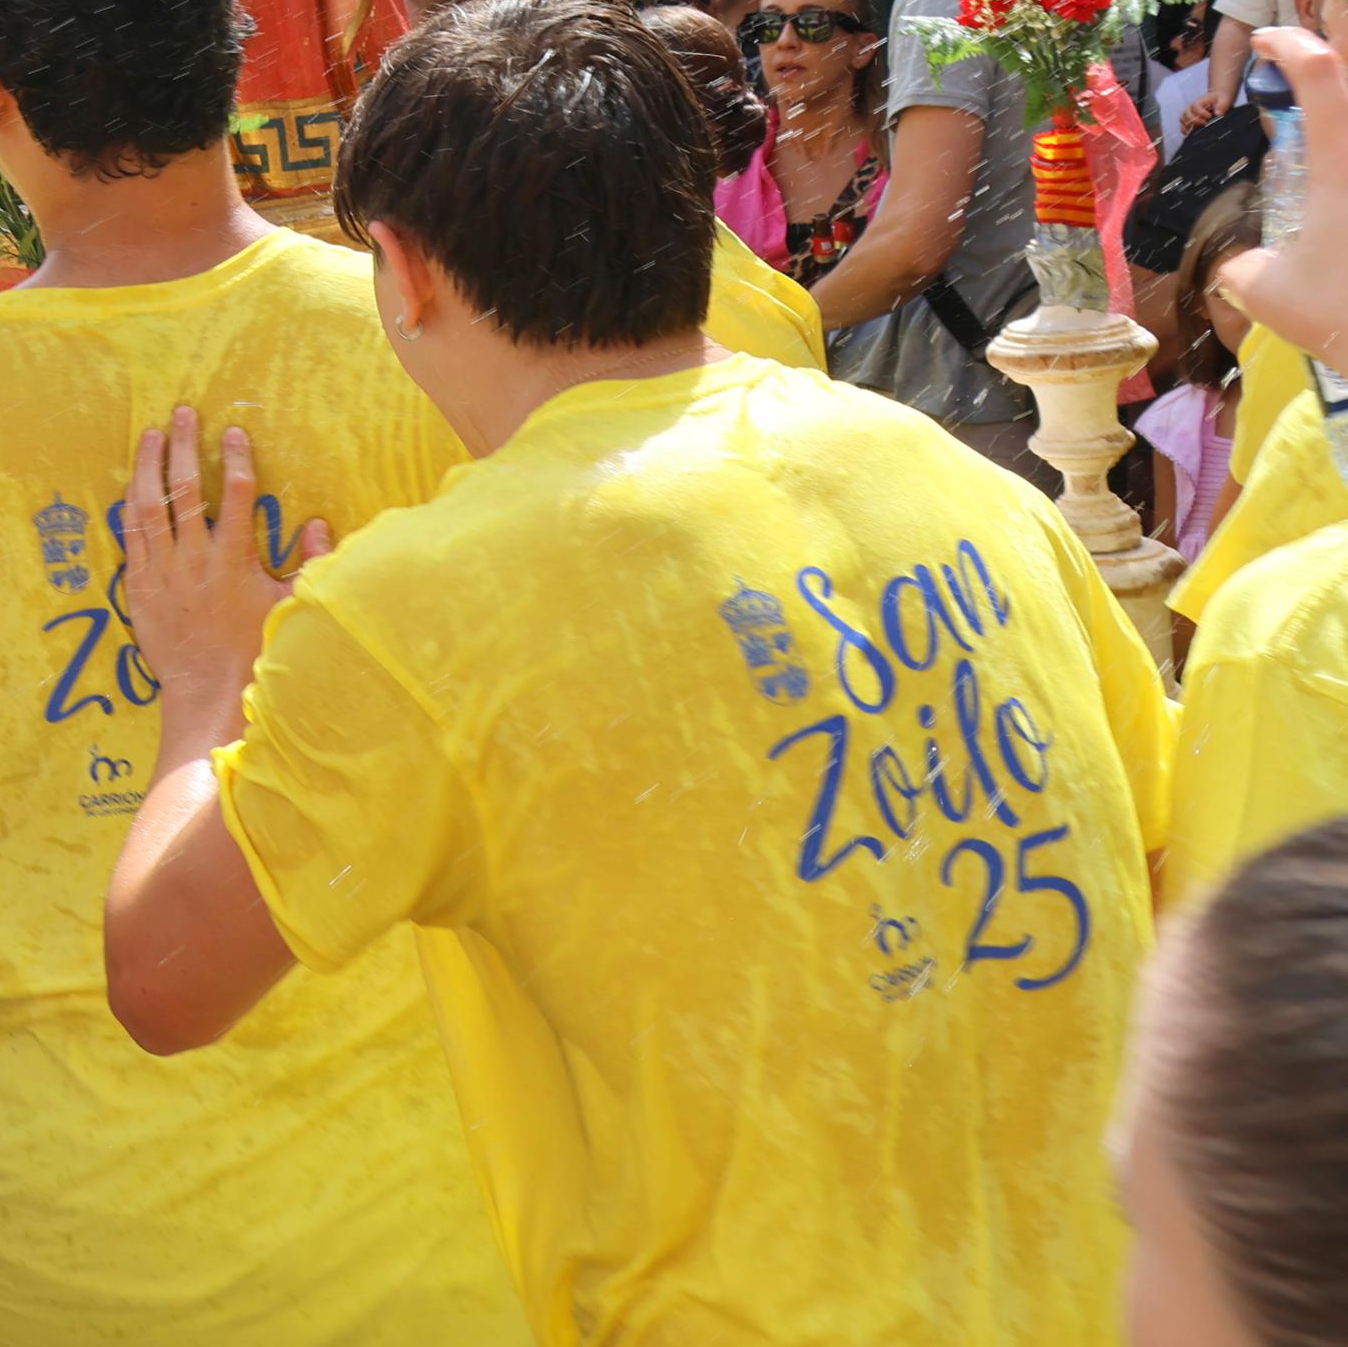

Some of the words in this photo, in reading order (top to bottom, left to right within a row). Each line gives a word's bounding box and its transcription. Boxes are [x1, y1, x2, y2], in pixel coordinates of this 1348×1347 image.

[795, 538, 1011, 714] San
[767, 658, 1054, 883] Zoilo
[940, 823, 1091, 992] 25
